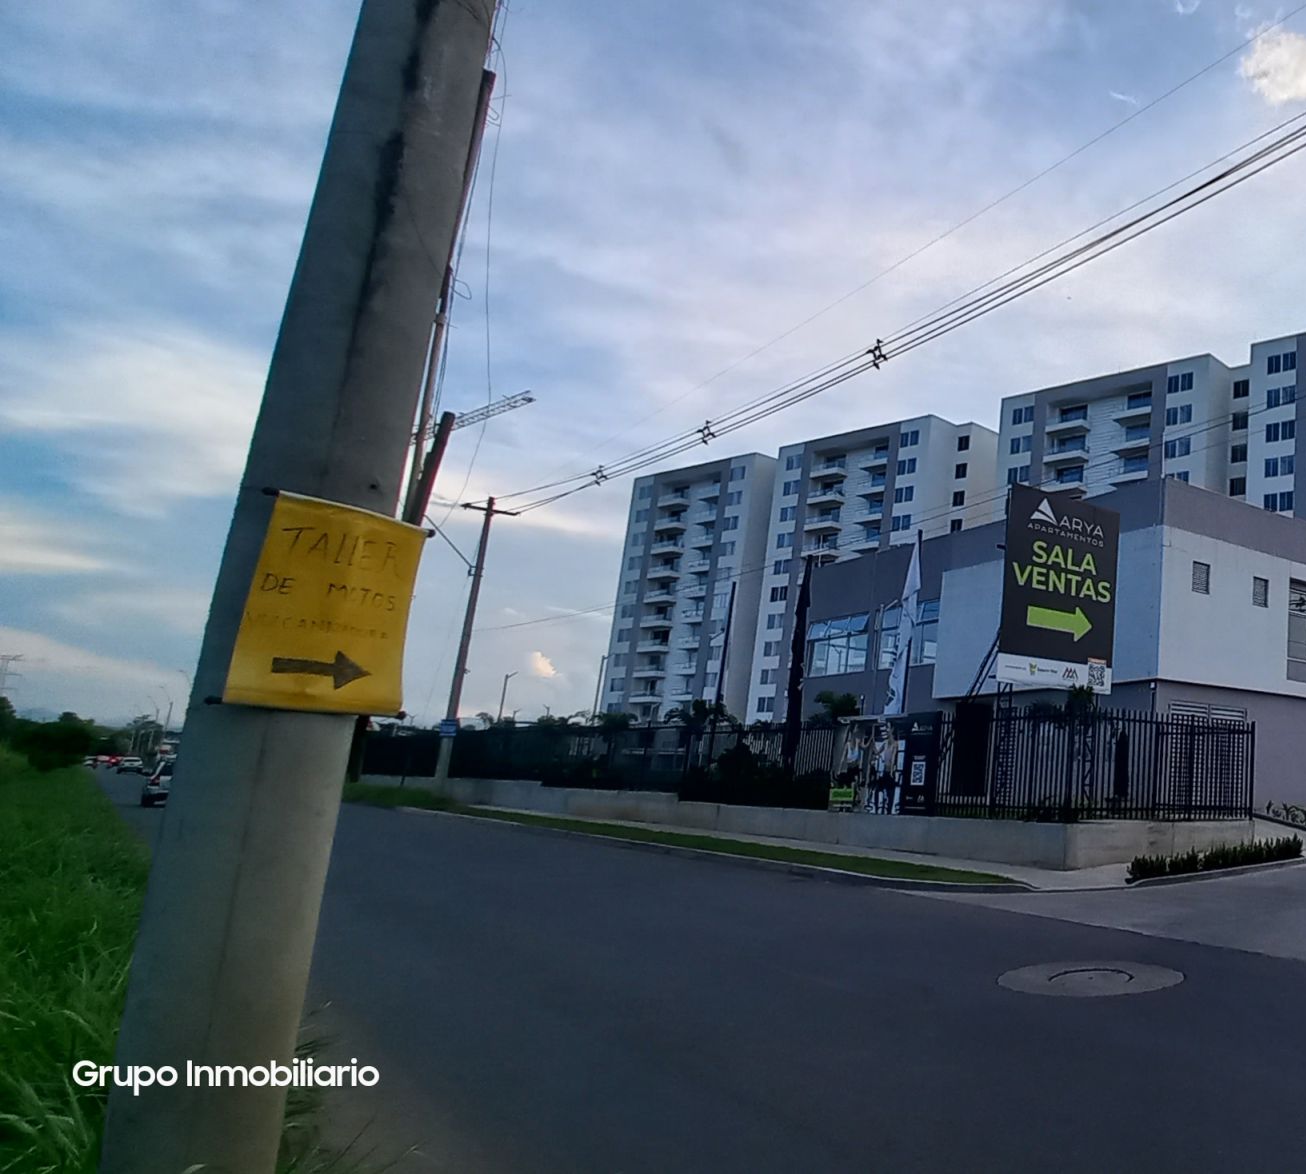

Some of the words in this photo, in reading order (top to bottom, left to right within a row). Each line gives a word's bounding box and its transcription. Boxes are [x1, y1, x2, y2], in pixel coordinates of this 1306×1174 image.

[1026, 522, 1105, 548] APARTAMENTOS
[1058, 515, 1104, 538] ARYA
[1032, 540, 1097, 575] SALA
[260, 572, 296, 595] DE
[1012, 561, 1111, 603] VENTAS
